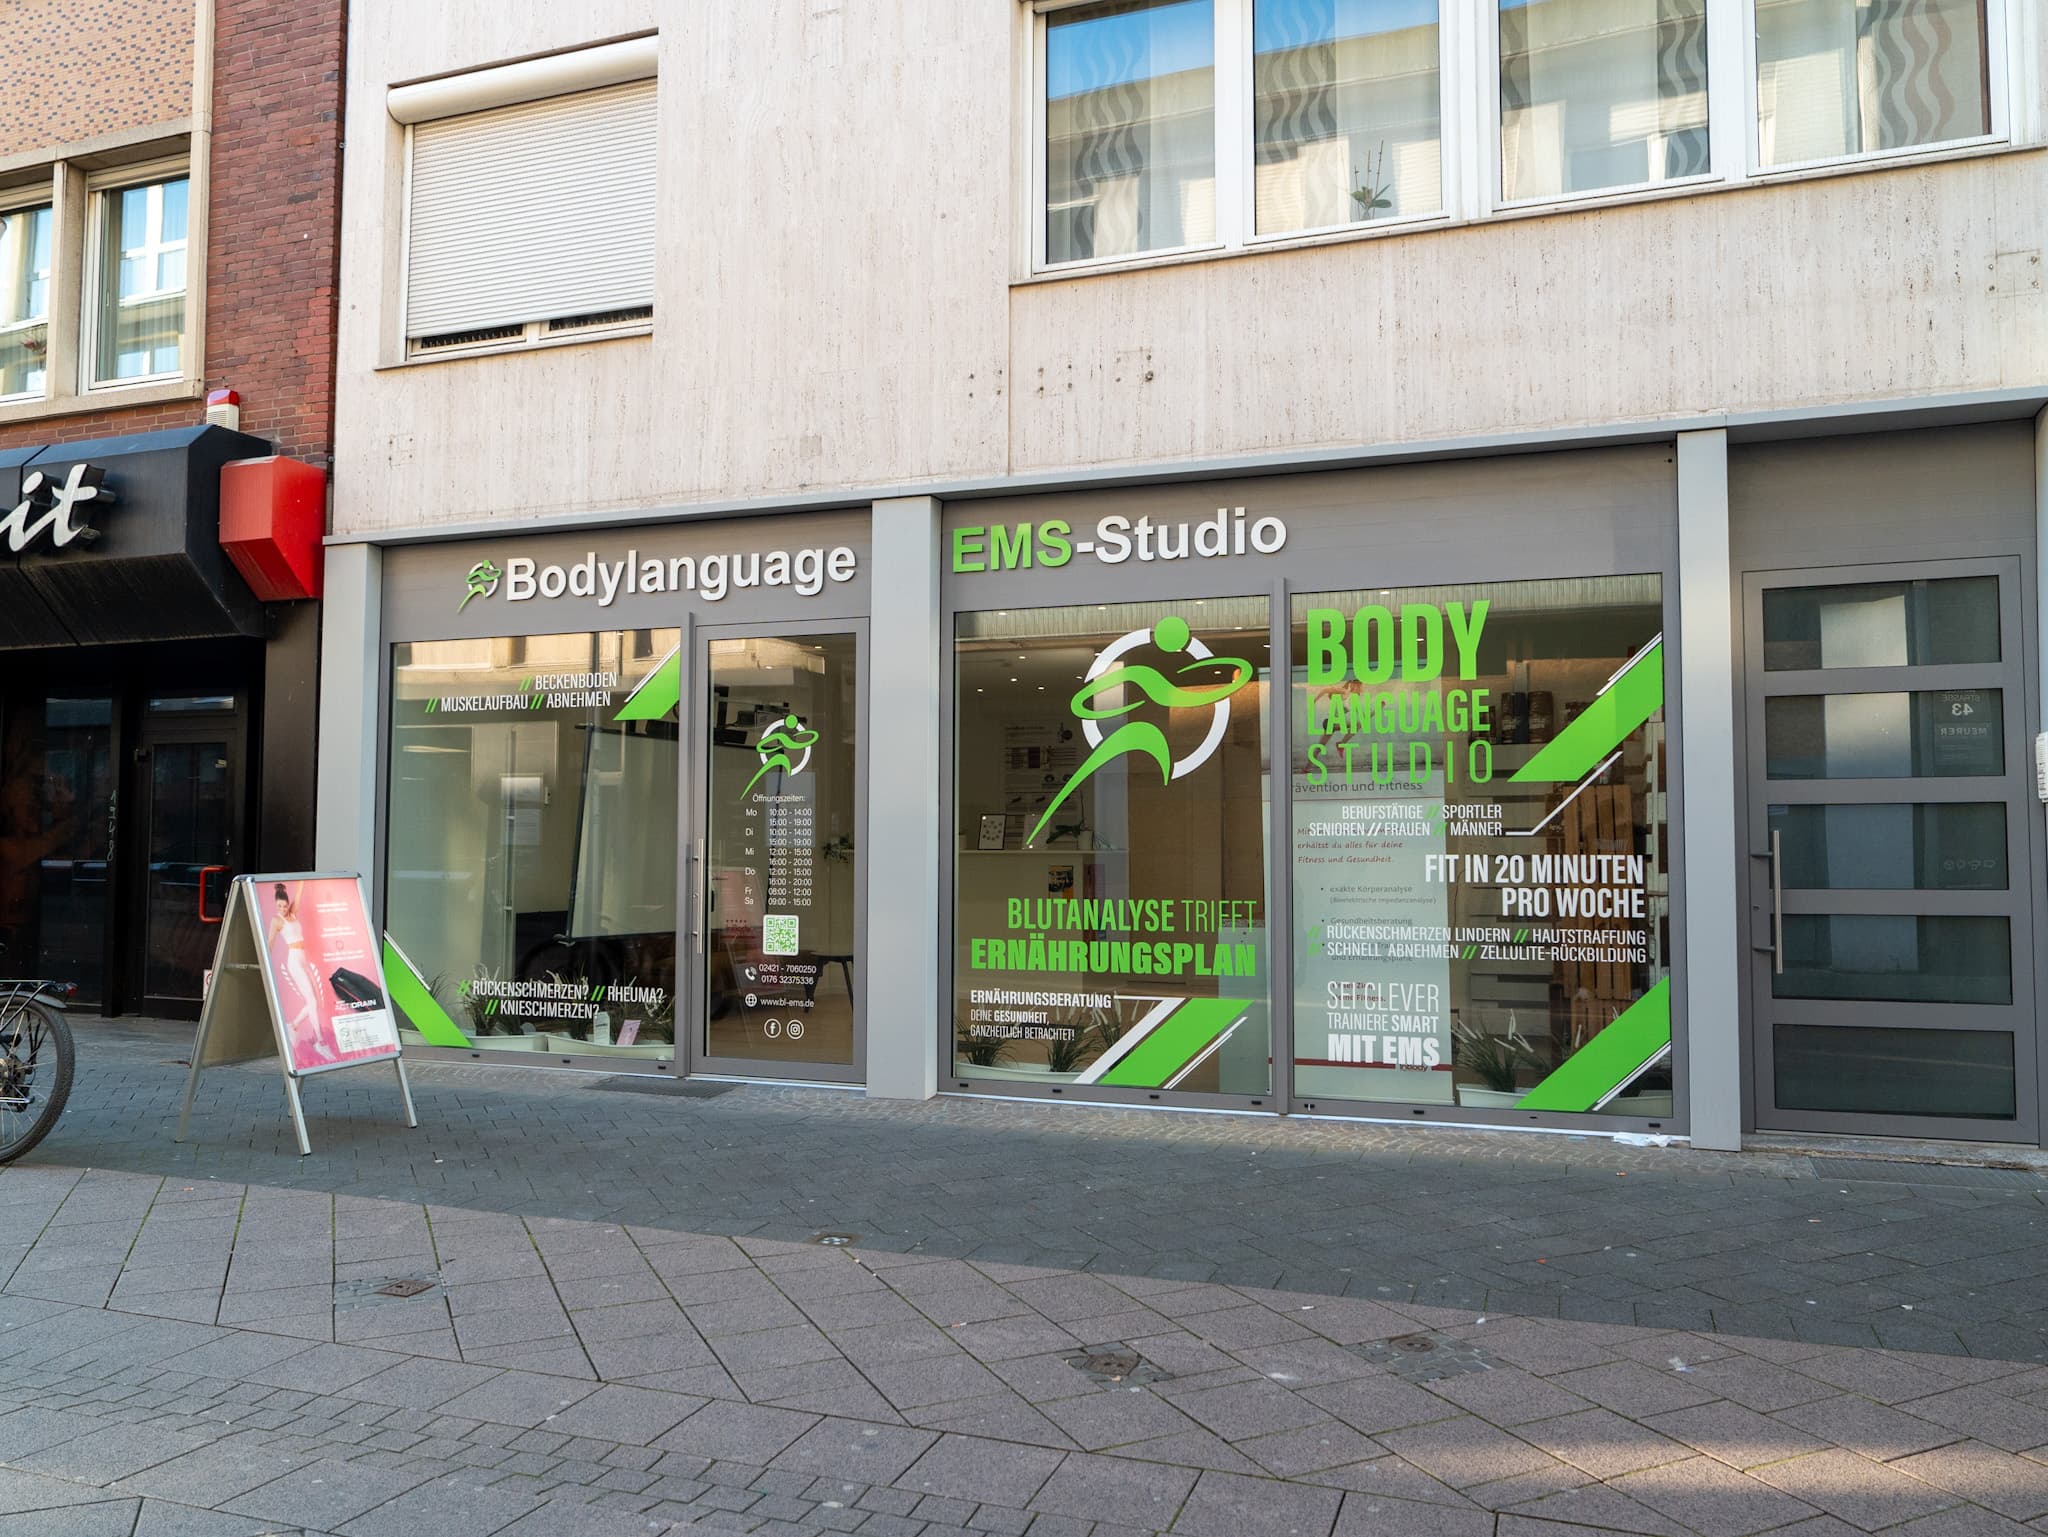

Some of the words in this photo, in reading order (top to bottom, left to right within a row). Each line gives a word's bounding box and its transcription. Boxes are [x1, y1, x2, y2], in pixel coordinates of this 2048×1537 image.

[952, 506, 1287, 573] EMS-Studio
[506, 546, 856, 606] Bodylanguage
[1307, 600, 1491, 686] BODY
[535, 672, 617, 691] BECKENBODEN
[440, 694, 528, 713] MUSKELAUFBAU
[546, 691, 611, 709] ABNEHMEN
[1307, 688, 1491, 736] LANGUAGE
[1306, 739, 1493, 786] STUDIO
[746, 808, 757, 817] Mo
[1342, 803, 1423, 820] BERUFSTÄTIGE
[1443, 804, 1502, 820] SPORTLER
[745, 828, 754, 836] Di
[1309, 822, 1365, 836] SENIOREN
[1384, 822, 1430, 836] FRAUEN
[1450, 819, 1503, 836] MÄNNER
[745, 848, 755, 856] Mi
[745, 867, 756, 875] Do
[1425, 854, 1459, 883] FIT
[1465, 854, 1489, 884] IN
[1495, 854, 1525, 884] 20
[1532, 854, 1644, 885] MINUTEN
[745, 887, 752, 895] Fr
[745, 897, 754, 905] Sa
[1502, 888, 1549, 917] PRO
[1555, 888, 1646, 919] WOCHE
[1008, 897, 1175, 932] BLUTANALYSE
[1181, 899, 1257, 933] TRIFFT
[1327, 923, 1451, 942] RÜCKENSCHMERZEN
[1455, 927, 1511, 943] LINDERN
[1532, 928, 1646, 946] HAUTSTRAFFUNG
[971, 932, 1257, 977] ERNÄHRUNGSPLAN
[1327, 941, 1381, 957] SCHNELL
[1388, 943, 1459, 959] ABNEHMEN
[1480, 944, 1647, 964] ZELLULITE-RÜCKBILDUNG
[472, 978, 589, 1001] RÜCKENSCHMERZEN?
[607, 985, 664, 1004] RHEUMA?
[970, 988, 1112, 1009] ERNÄHRUNGSBERATUNG
[1327, 980, 1356, 1010] SEI
[1364, 982, 1440, 1013] CLEVER
[500, 1000, 600, 1019] KNIESCHMERZEN?
[970, 1009, 993, 1022] DEINE
[993, 1010, 1050, 1025] GESUNDHEIT,
[970, 1024, 1023, 1039] GANZHEITLICH
[1025, 1026, 1075, 1041] BETRACHTET!
[1327, 1012, 1389, 1032] TRAINIERE
[1391, 1014, 1439, 1033] SMART
[1328, 1033, 1377, 1064] MIT
[1382, 1035, 1440, 1067] EMS
